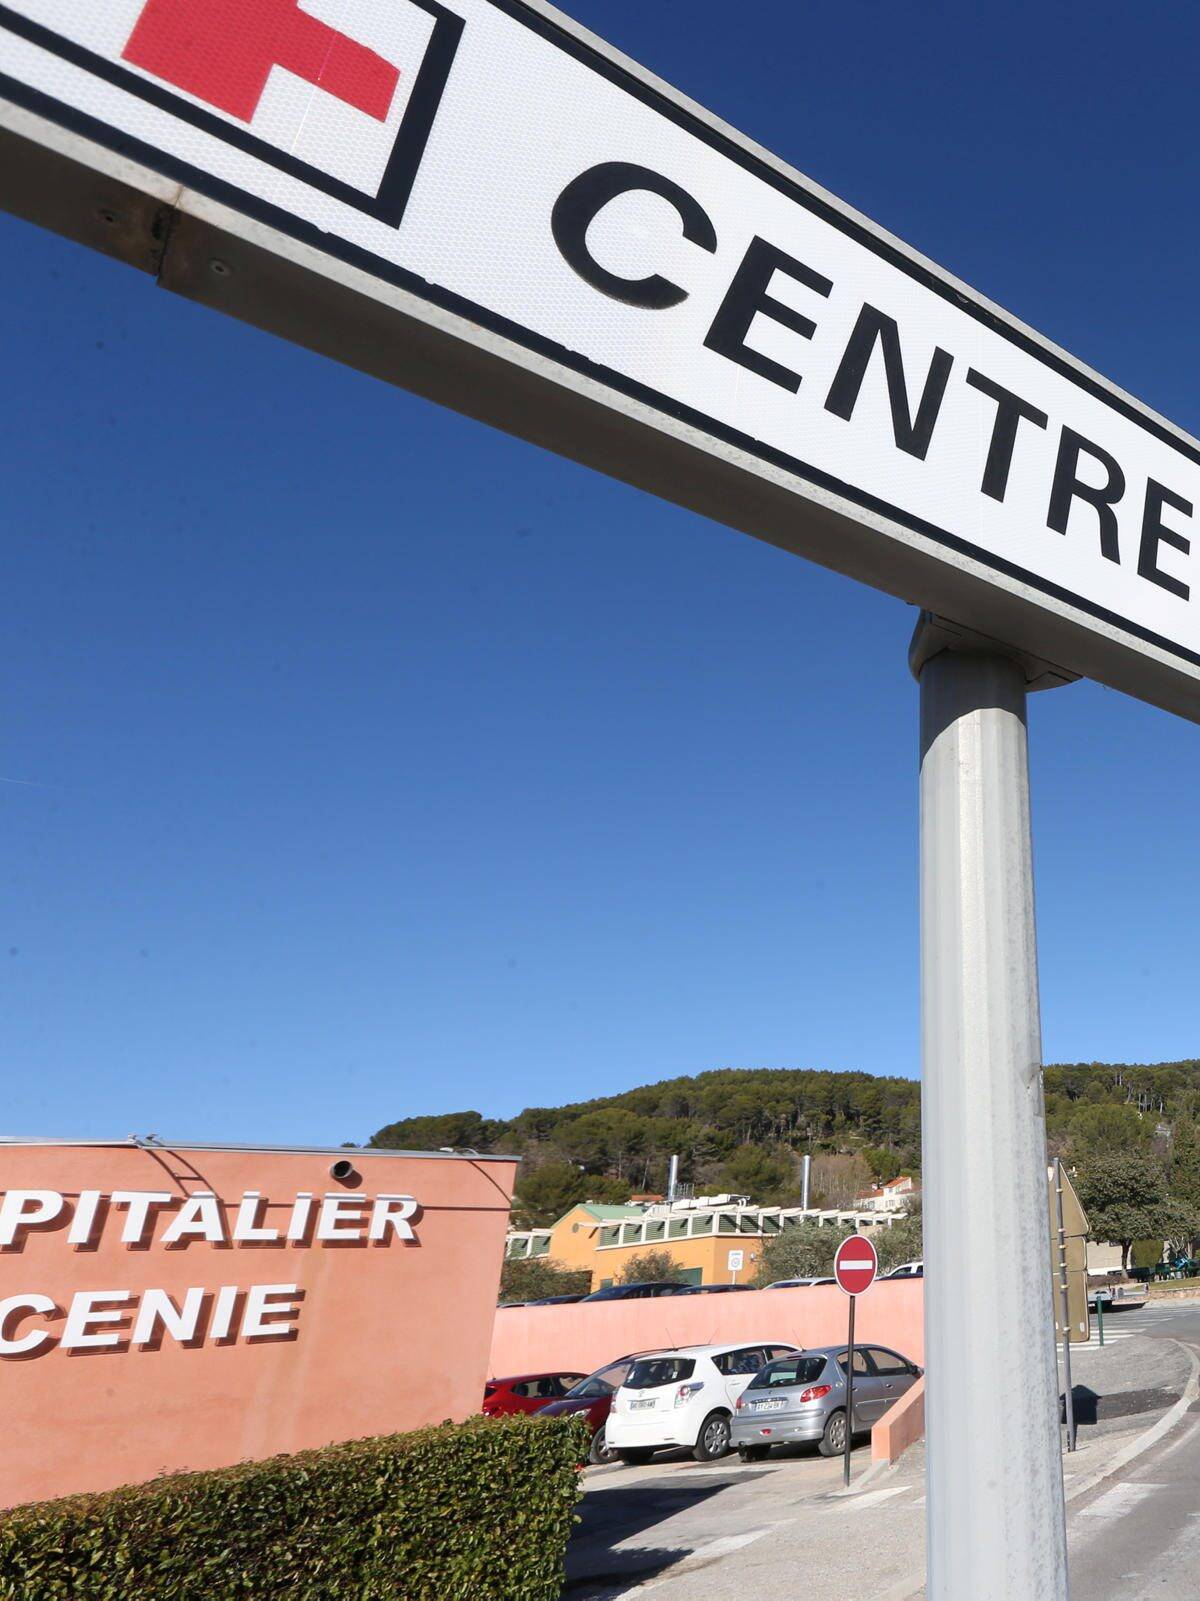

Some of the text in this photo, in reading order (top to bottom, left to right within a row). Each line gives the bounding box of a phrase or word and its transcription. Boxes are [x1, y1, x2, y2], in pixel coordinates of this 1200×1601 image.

[551, 161, 1194, 601] CENTRE
[0, 1190, 418, 1245] PITALIER
[0, 1283, 298, 1354] CENIE
